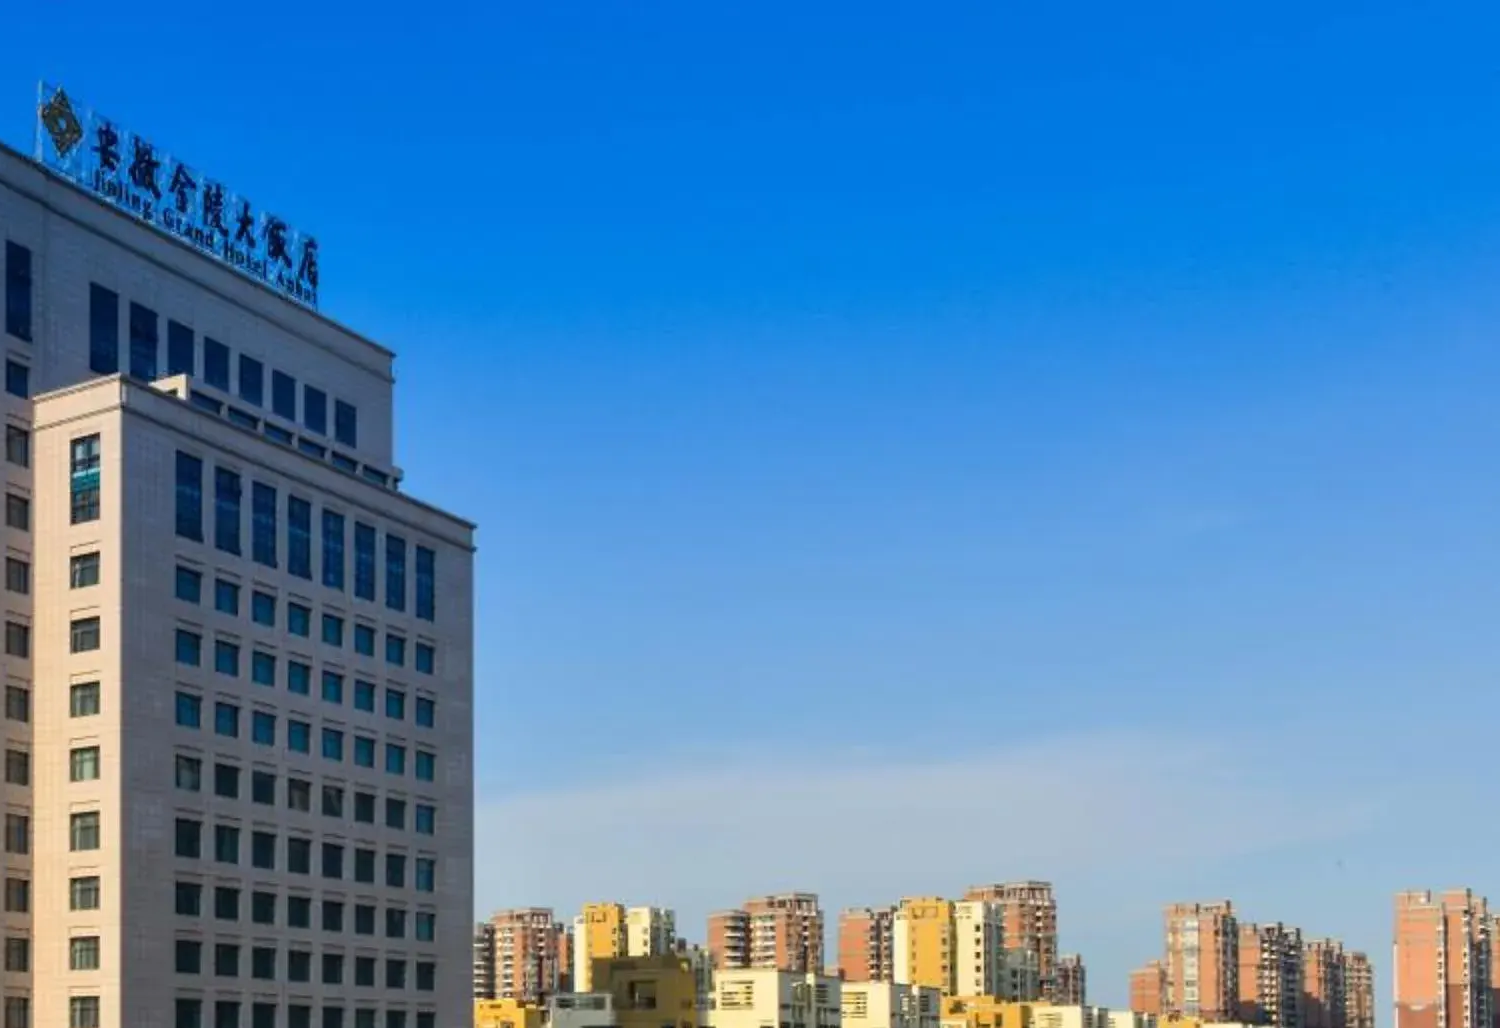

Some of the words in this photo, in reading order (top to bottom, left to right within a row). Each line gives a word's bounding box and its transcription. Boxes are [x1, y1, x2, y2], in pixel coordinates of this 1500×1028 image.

[93, 167, 154, 220] Jinling
[162, 207, 214, 248] Grand
[223, 237, 268, 280] Hotel
